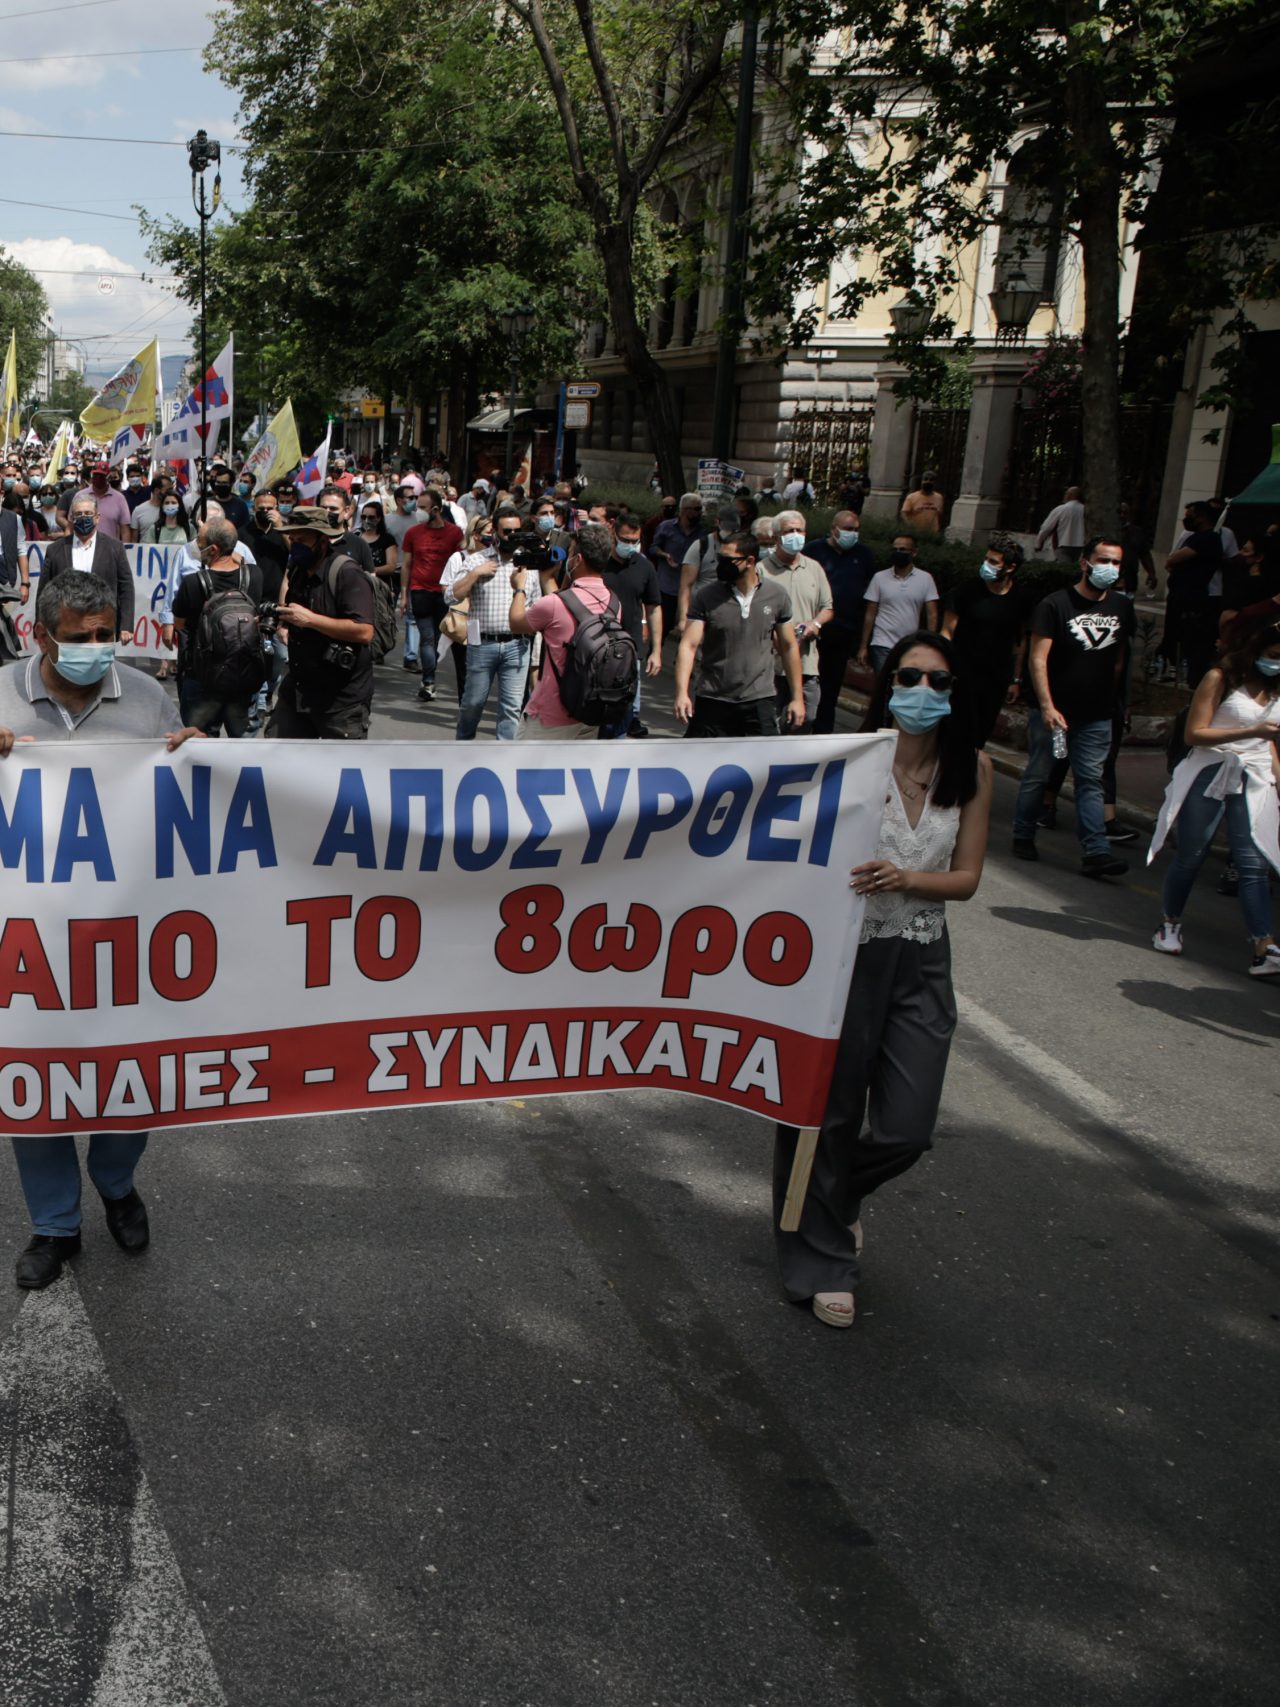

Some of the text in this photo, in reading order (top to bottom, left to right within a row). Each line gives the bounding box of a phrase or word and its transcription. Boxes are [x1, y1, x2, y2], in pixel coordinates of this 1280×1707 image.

[154, 764, 278, 879] ΝΑ
[313, 758, 847, 871] ΑΠΟΣΥΡΘΕΙ
[286, 893, 422, 989] ΤΟ
[494, 884, 814, 999] 8ωρο
[366, 1019, 784, 1107] ΣΥΝΔΙΚΑΤΑ
